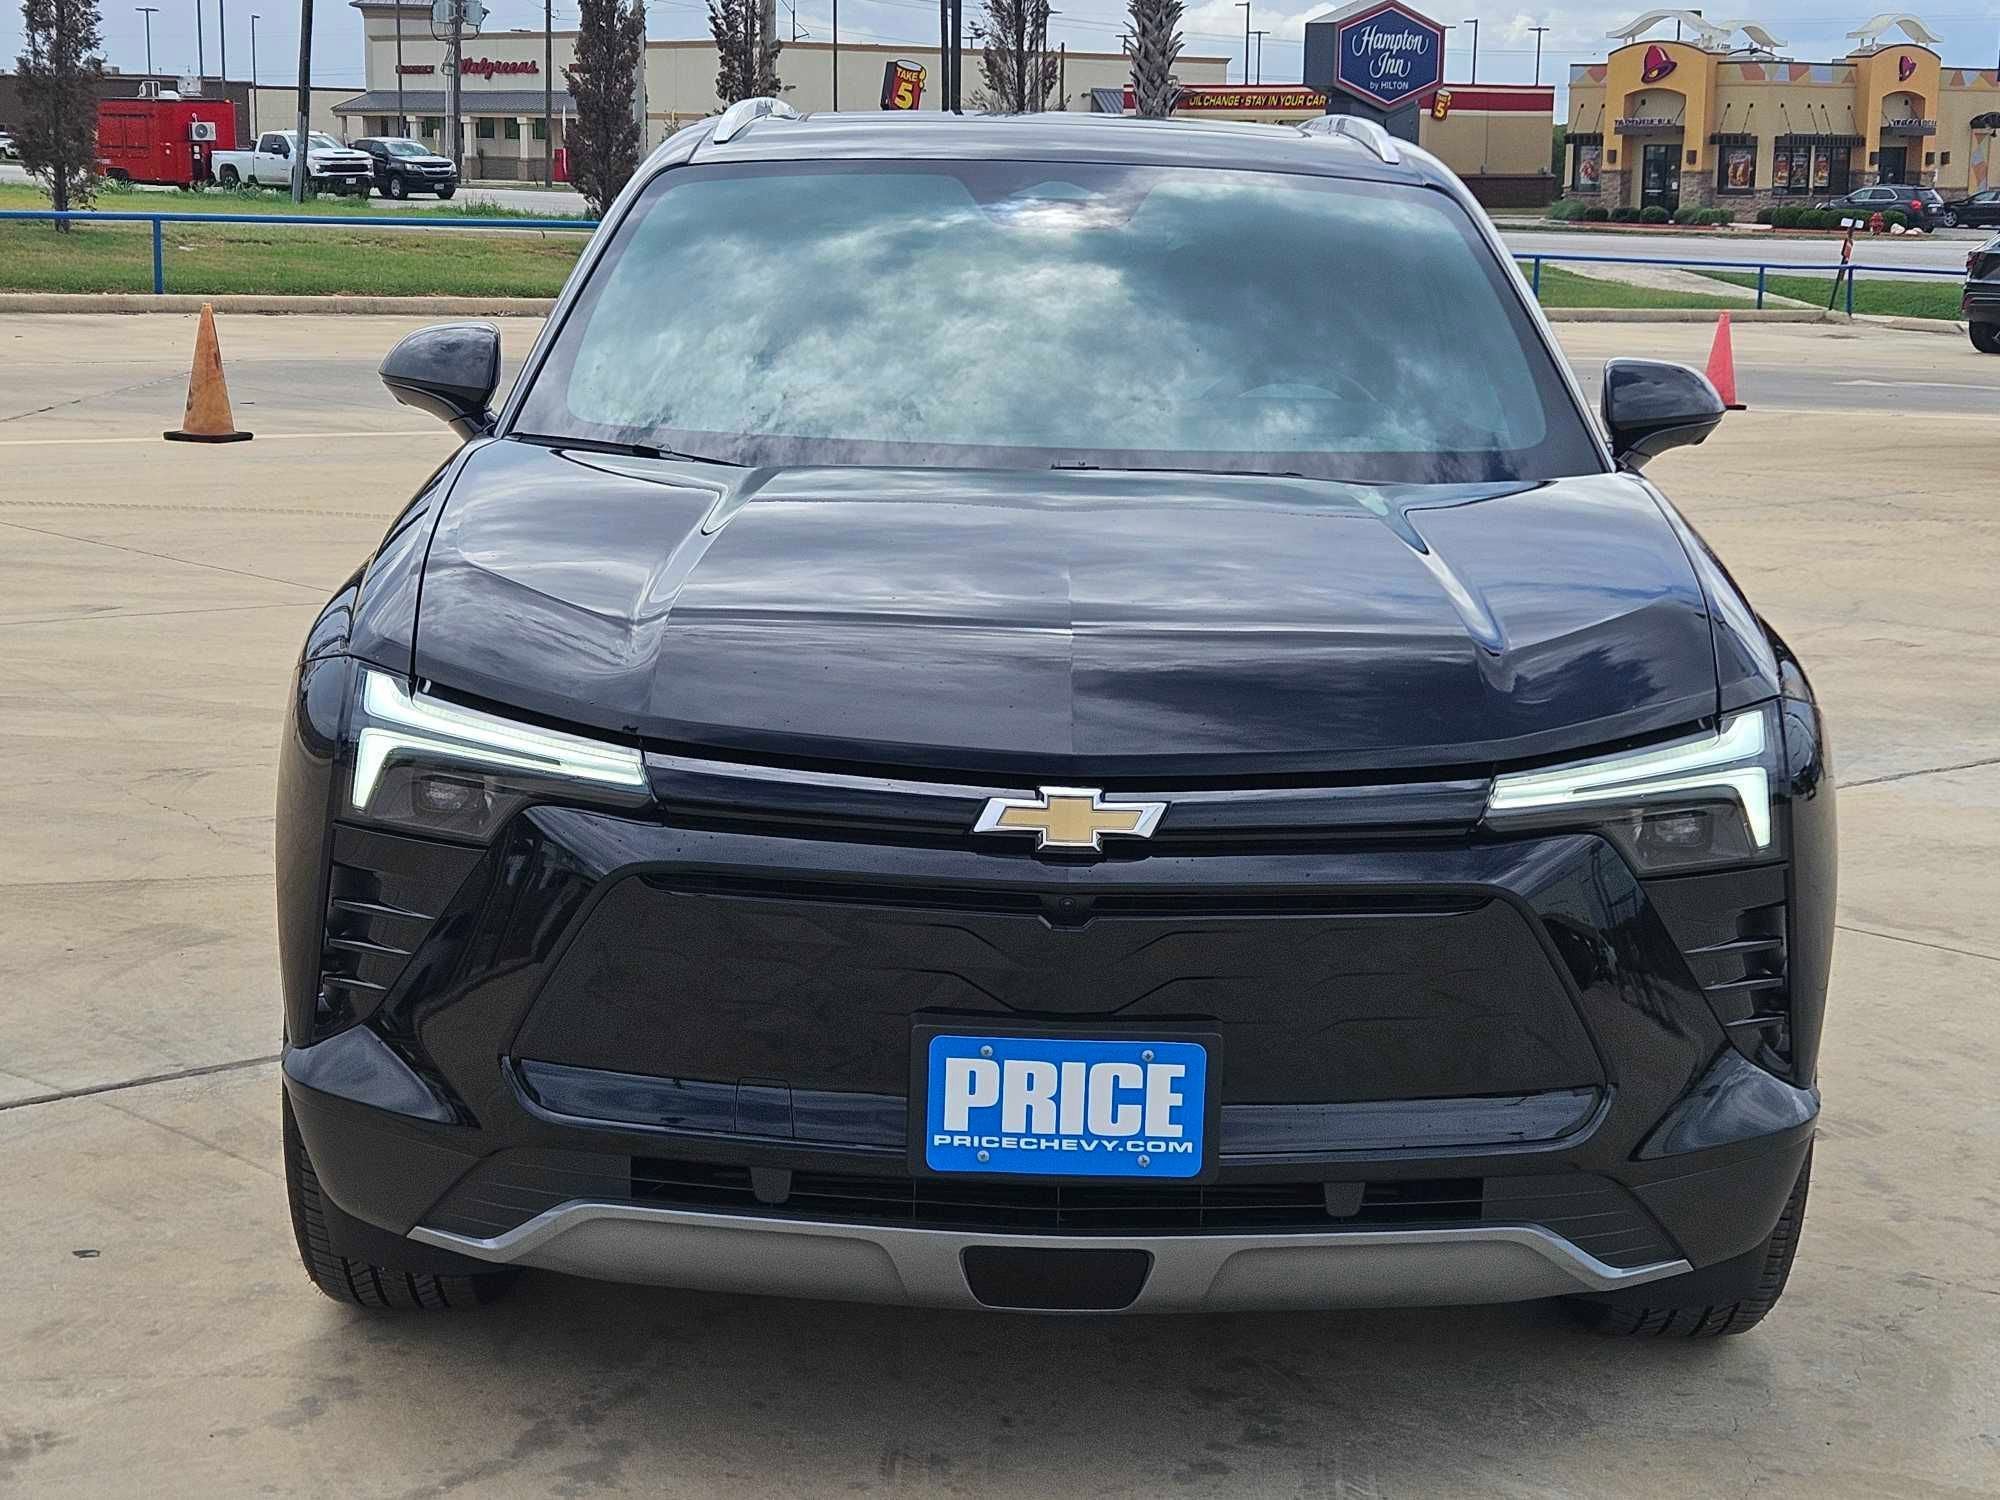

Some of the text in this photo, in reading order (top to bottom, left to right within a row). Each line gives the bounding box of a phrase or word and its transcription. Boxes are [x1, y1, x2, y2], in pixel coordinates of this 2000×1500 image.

[1351, 25, 1429, 56] Hampton
[896, 66, 919, 82] TAKE
[1369, 52, 1411, 78] Inn
[894, 81, 913, 109] 5
[1369, 81, 1409, 91] by HILTON
[1203, 95, 1240, 106] CHANGE
[1245, 95, 1268, 106] STAY
[1267, 95, 1278, 106] IN
[1280, 95, 1305, 106] YOUR
[1306, 95, 1327, 106] CAR
[1434, 101, 1446, 118] 5
[944, 1057, 1186, 1138] PRICE
[933, 1134, 1193, 1154] PRICECHEVY.COM
